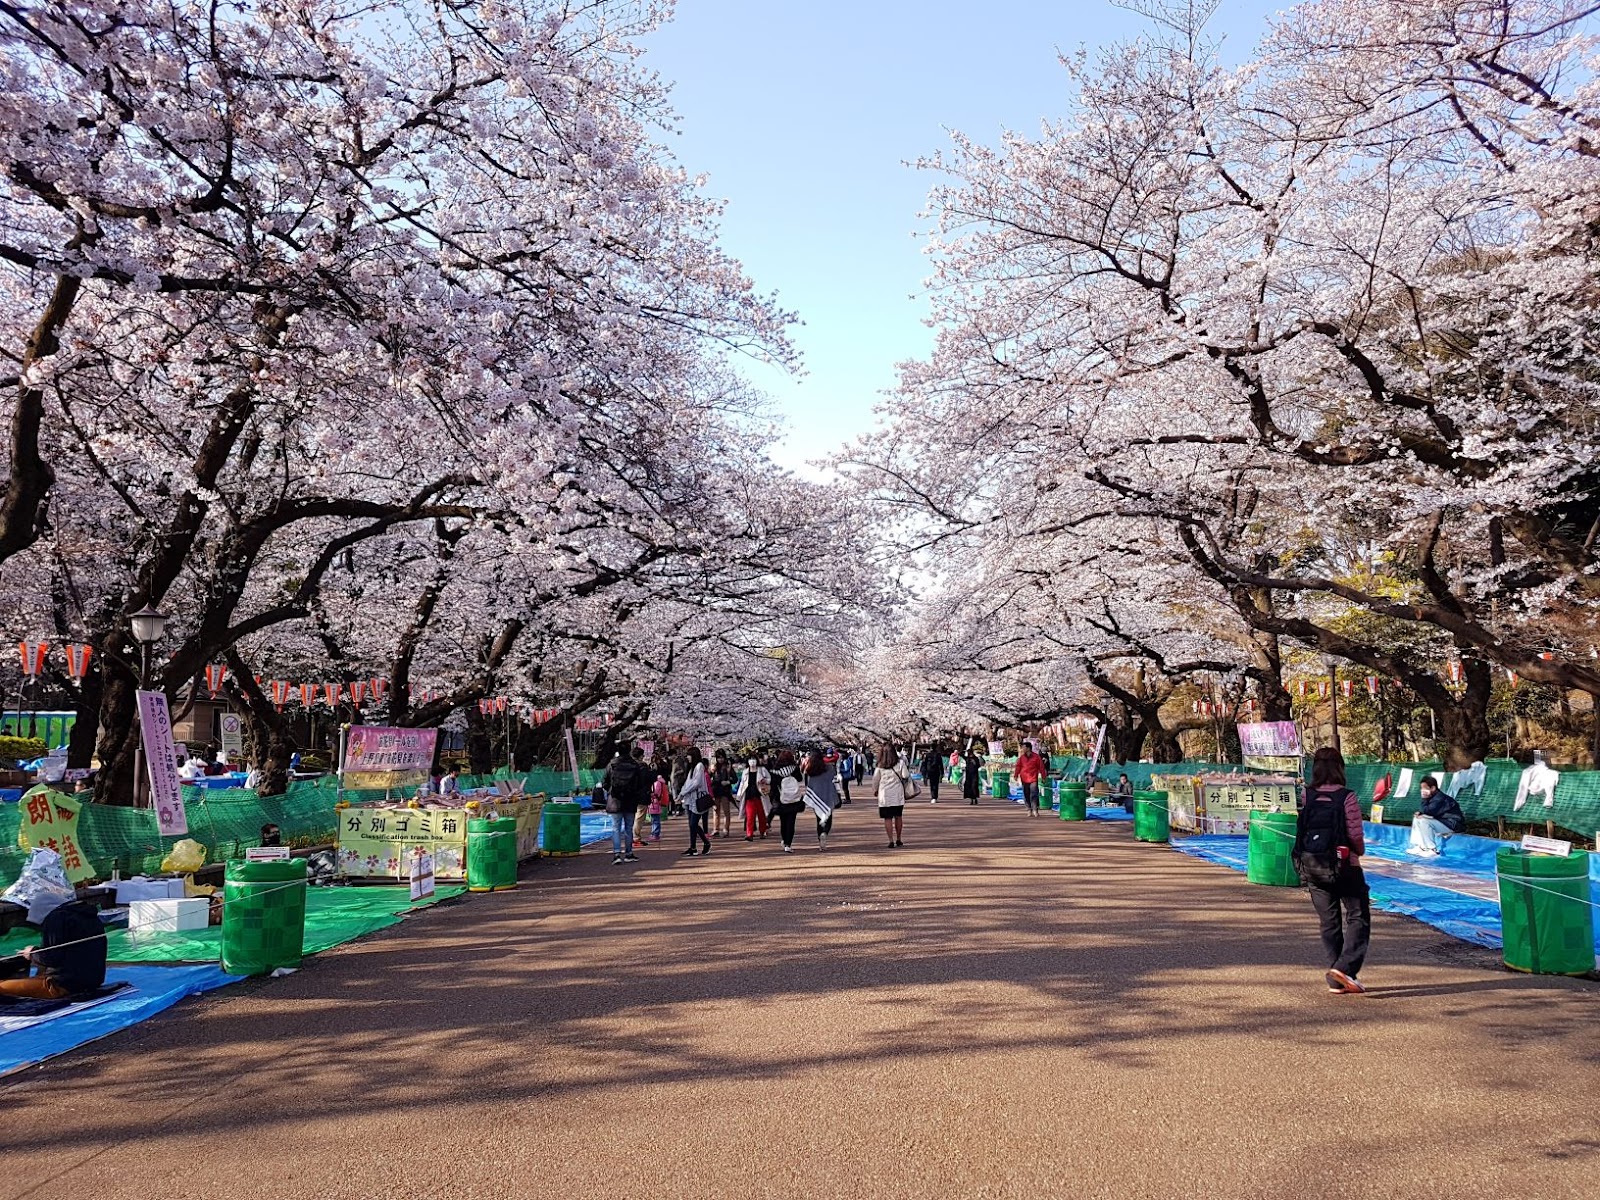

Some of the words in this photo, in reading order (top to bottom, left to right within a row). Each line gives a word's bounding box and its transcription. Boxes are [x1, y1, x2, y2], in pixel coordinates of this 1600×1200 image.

[155, 697, 180, 812] 無人のシートは処分します
[1210, 791, 1290, 803] 分別ゴミ箱
[347, 817, 457, 834] 分別ゴミ箱
